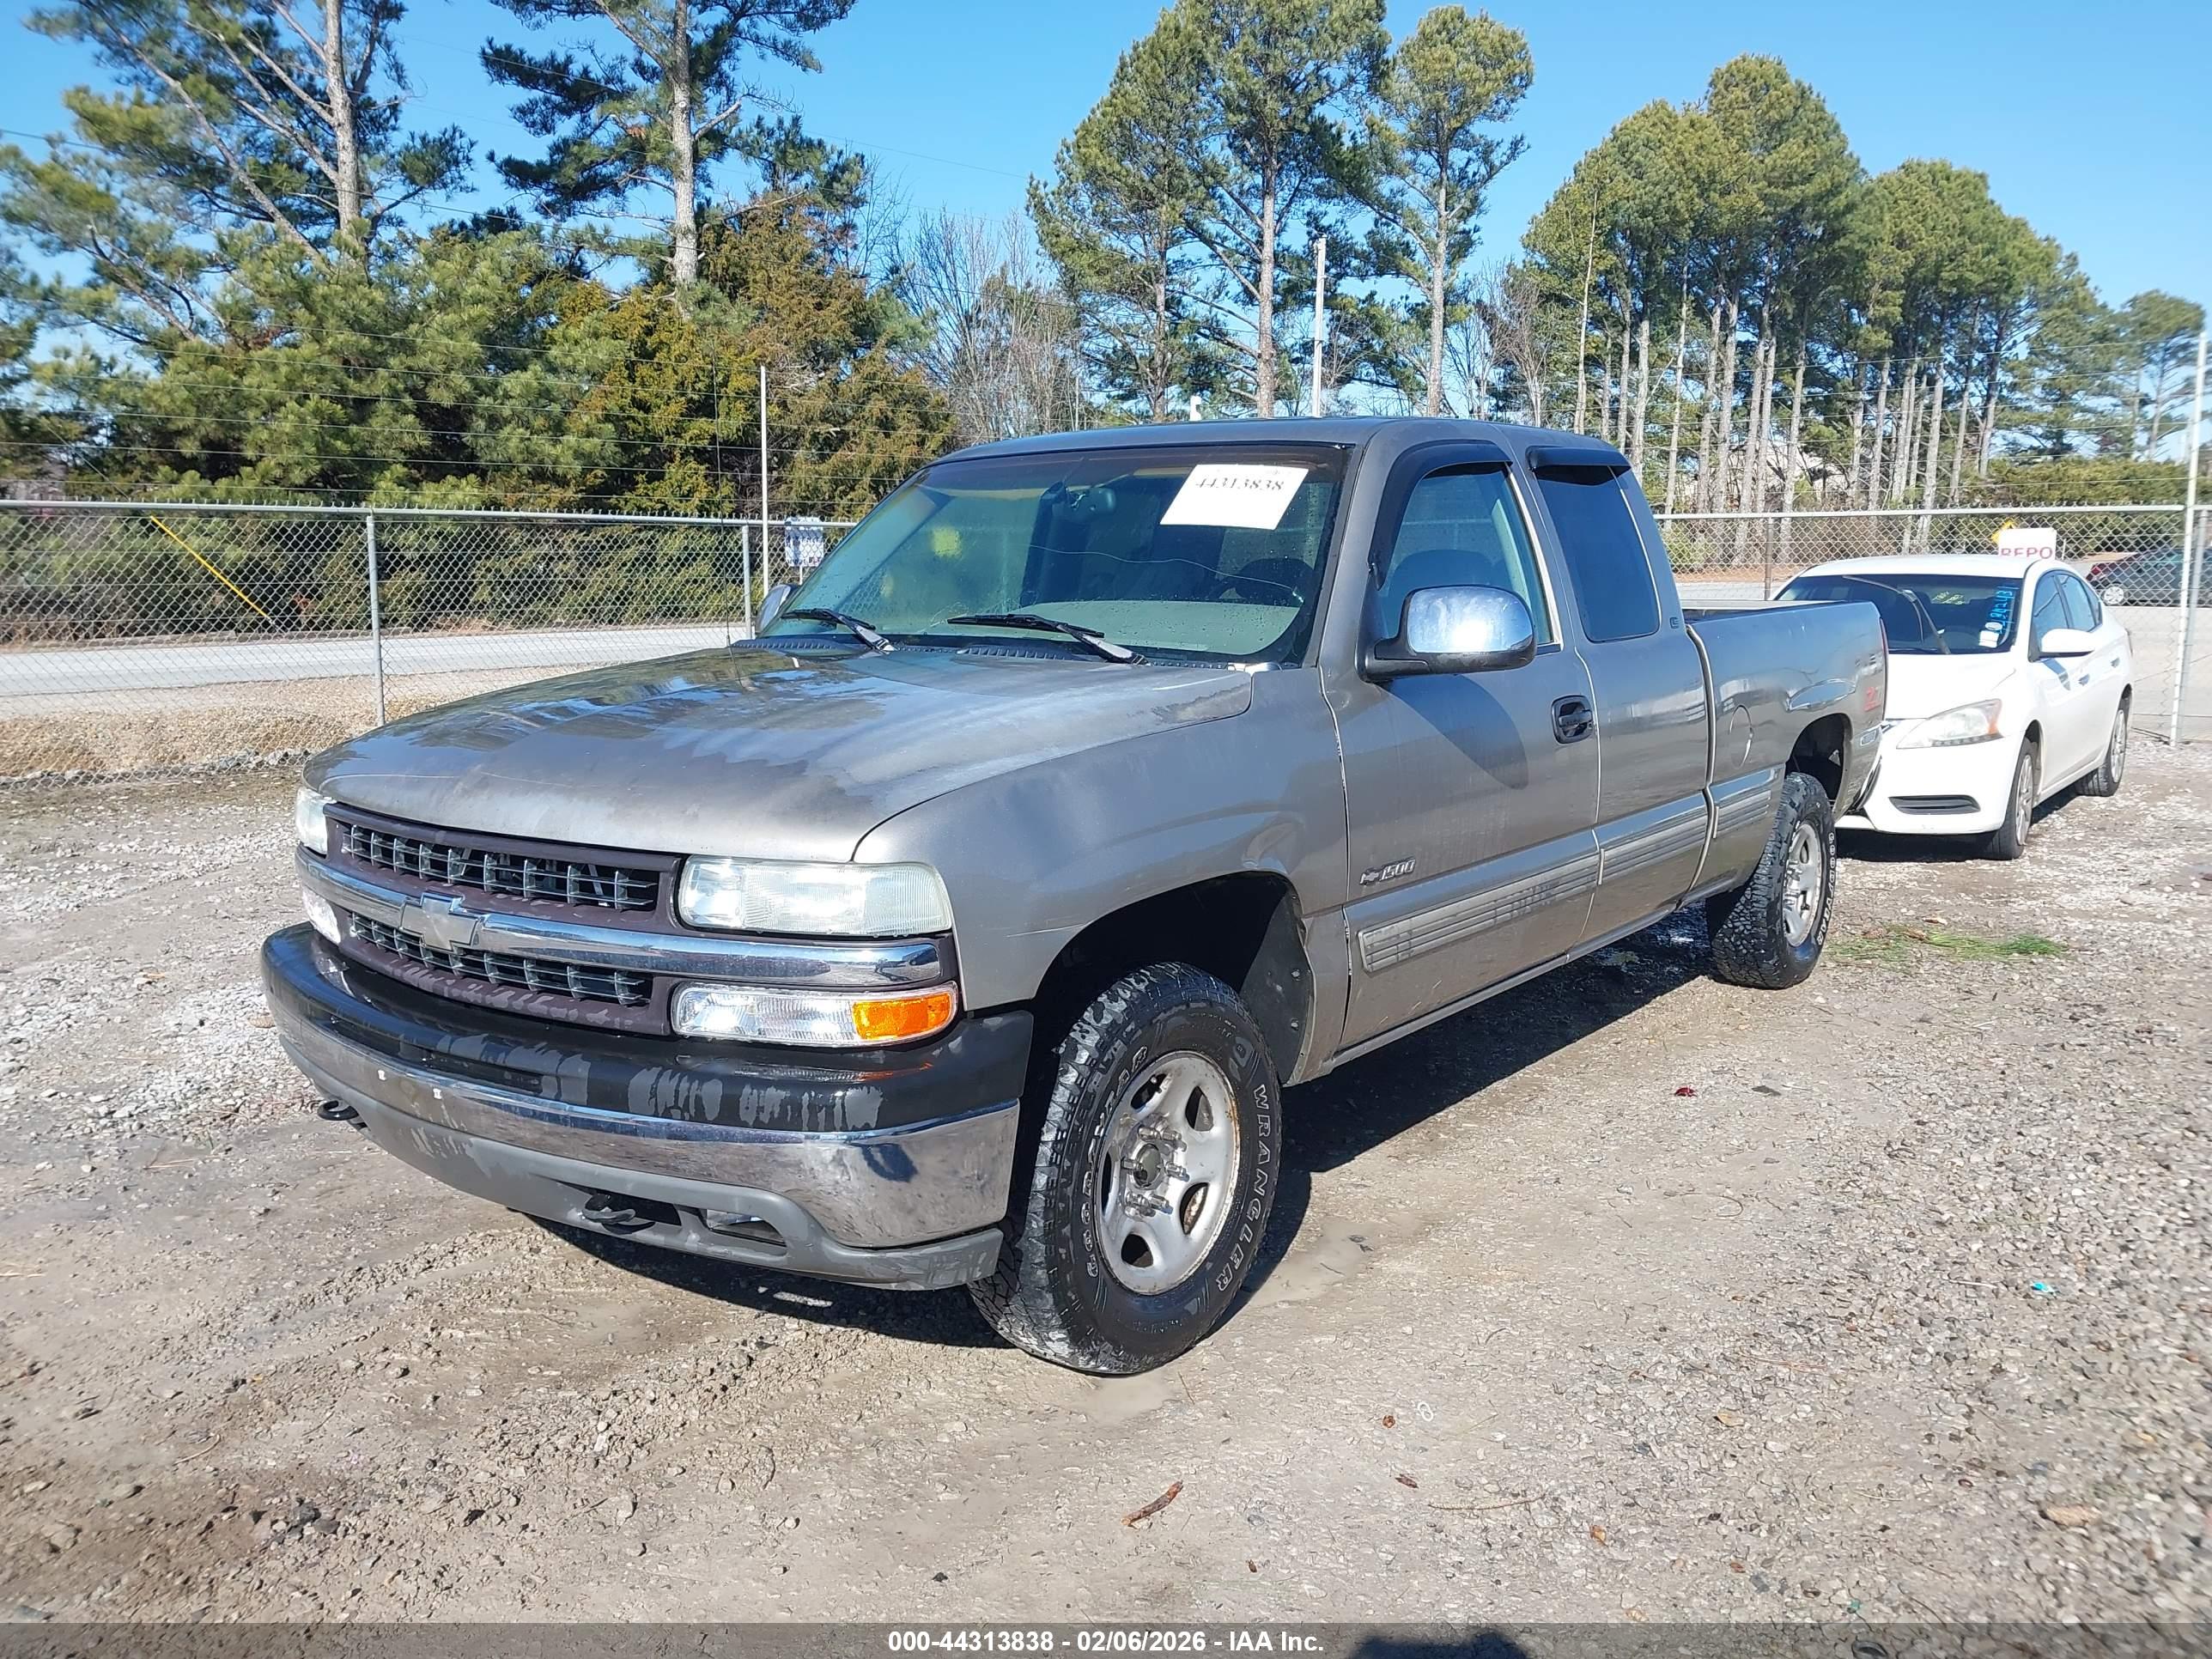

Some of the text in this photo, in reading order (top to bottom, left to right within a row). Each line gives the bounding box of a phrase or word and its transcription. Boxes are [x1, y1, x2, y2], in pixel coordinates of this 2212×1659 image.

[1194, 477, 1285, 491] 44313838
[1378, 858, 1416, 882] 1500
[1215, 1084, 1272, 1292] WRANGLER
